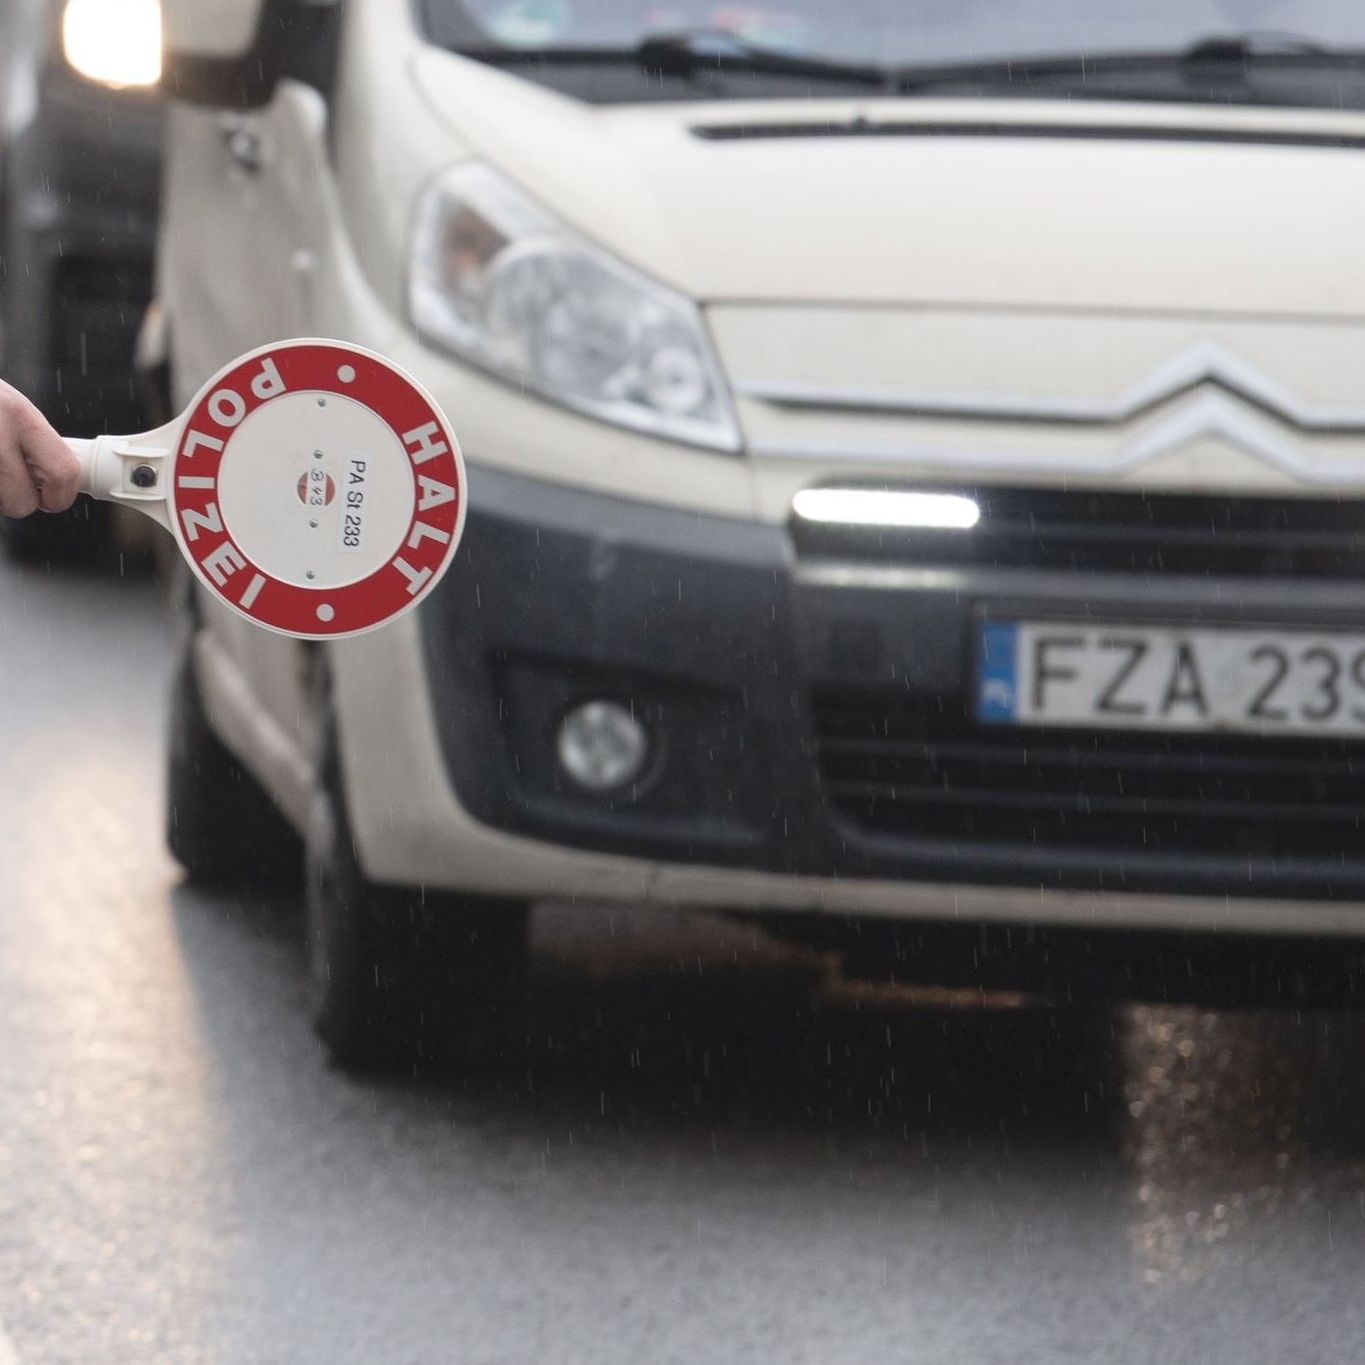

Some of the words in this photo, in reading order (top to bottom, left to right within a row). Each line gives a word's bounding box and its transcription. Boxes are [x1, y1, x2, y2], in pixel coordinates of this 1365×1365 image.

[178, 357, 287, 610] POLIZEI
[346, 491, 364, 509] St
[349, 460, 366, 484] PA
[343, 515, 361, 547] 233
[392, 421, 455, 595] HALT
[1031, 636, 1209, 716] FZA
